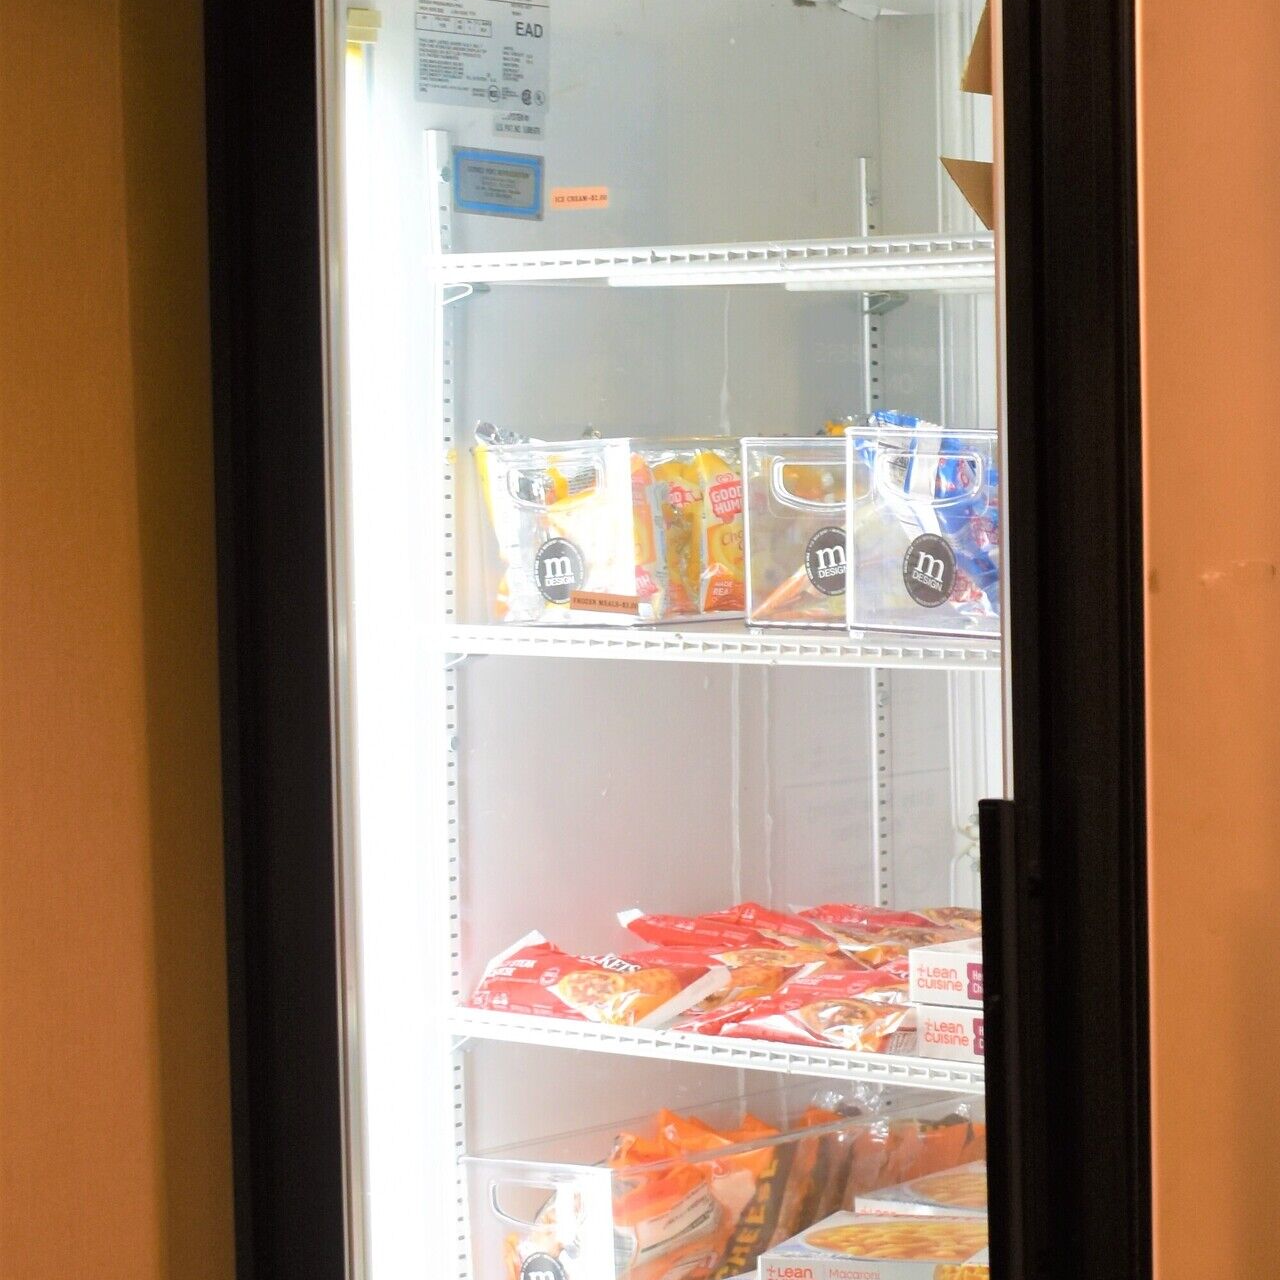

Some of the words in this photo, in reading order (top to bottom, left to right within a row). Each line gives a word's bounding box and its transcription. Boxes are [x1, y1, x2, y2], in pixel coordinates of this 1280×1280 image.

[516, 22, 543, 38] EAD
[911, 571, 943, 592] DESIGN
[829, 1268, 881, 1280] Macaroni
